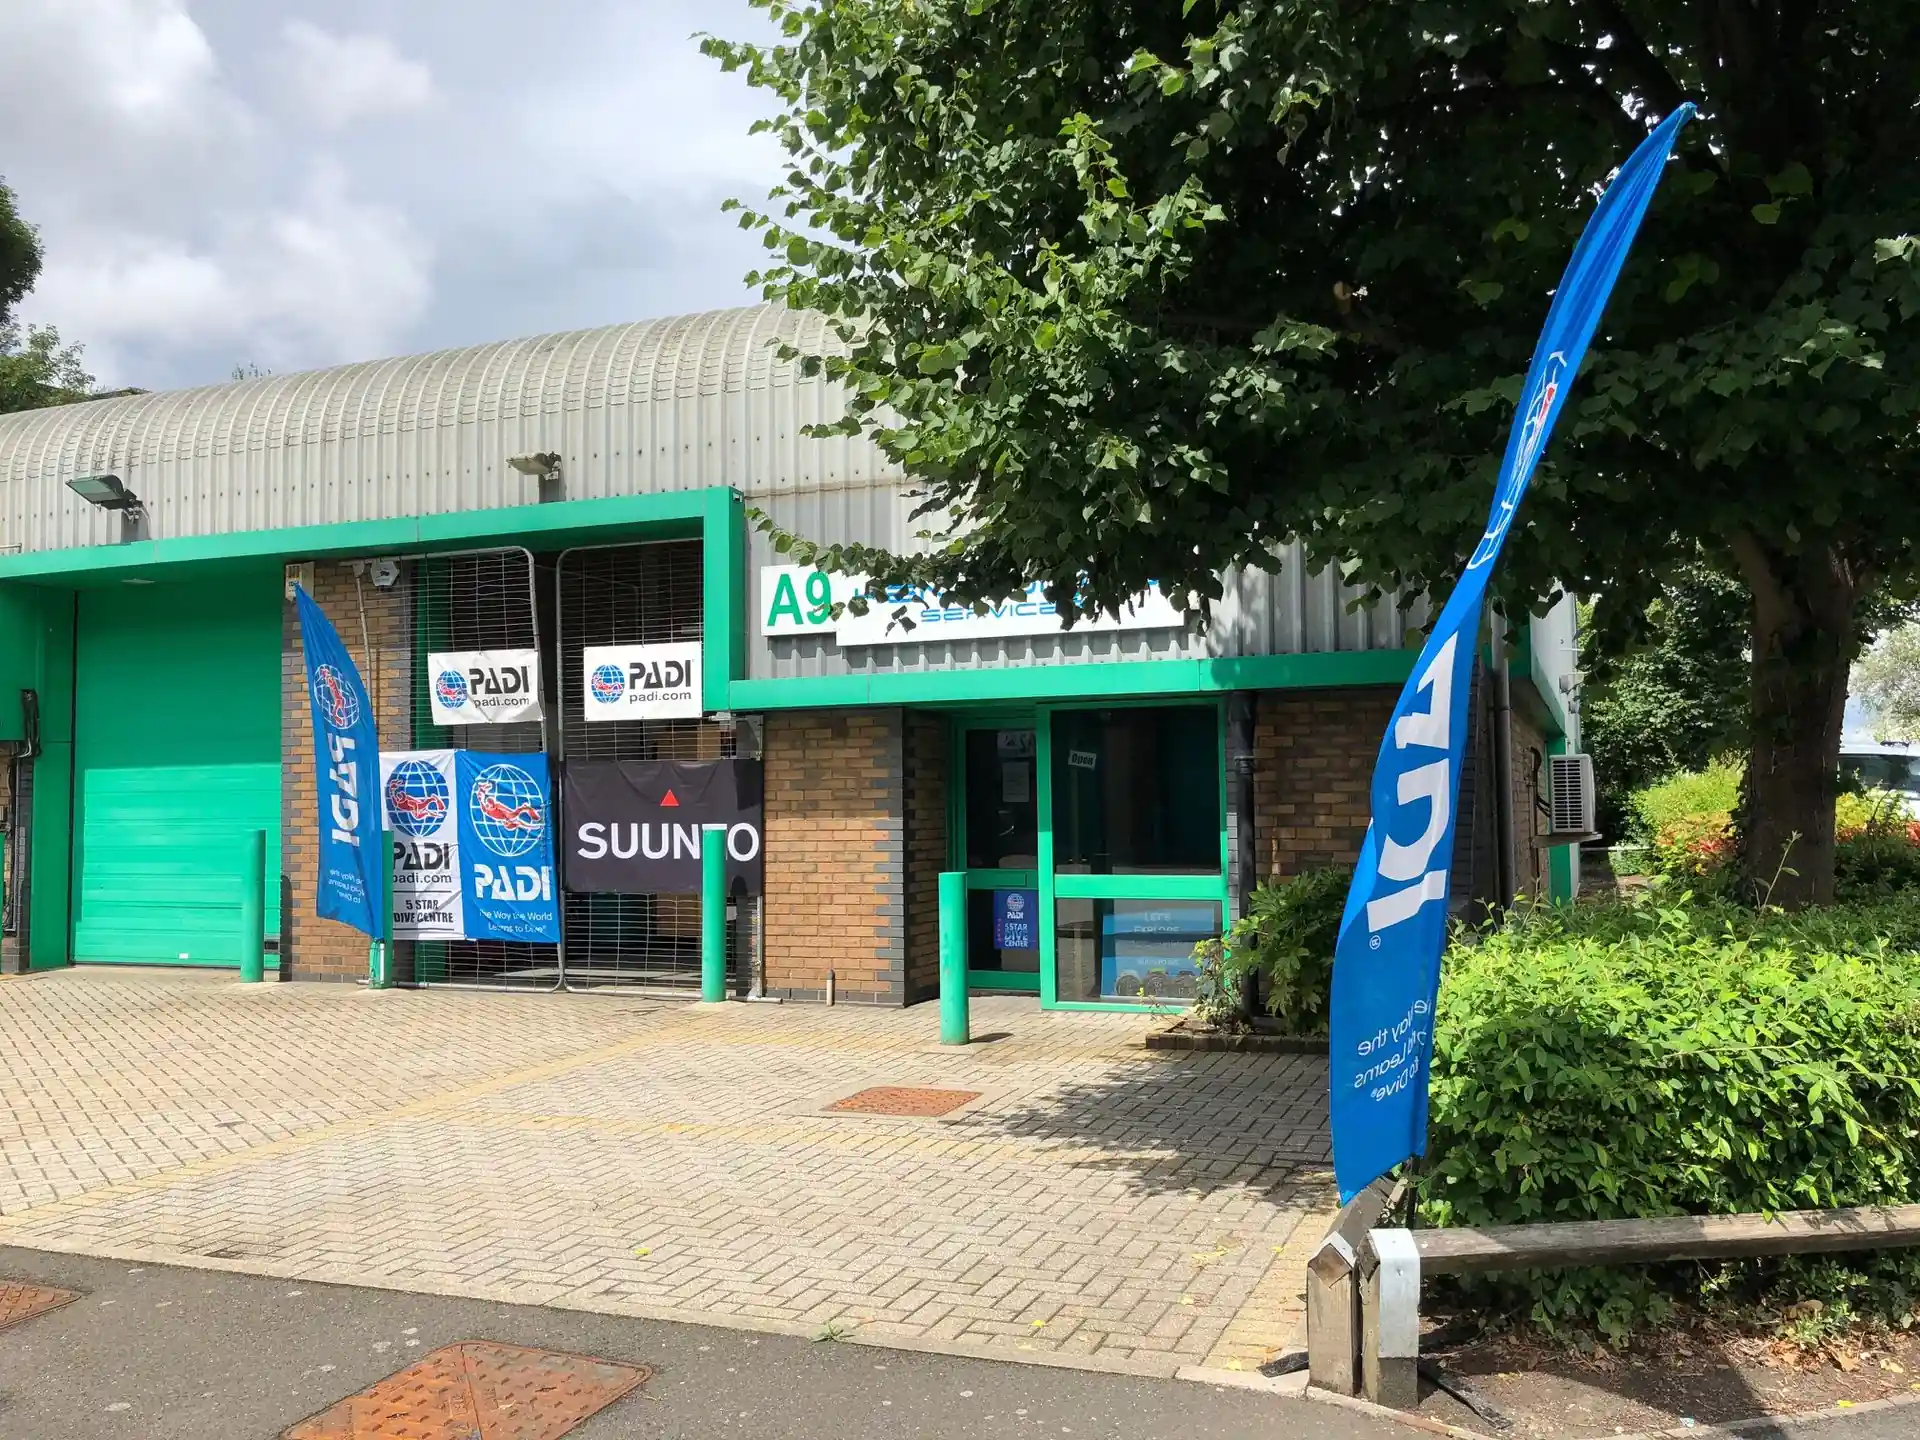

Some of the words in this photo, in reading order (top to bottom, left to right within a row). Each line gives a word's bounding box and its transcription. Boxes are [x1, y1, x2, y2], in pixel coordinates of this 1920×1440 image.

[767, 572, 831, 627] A9
[469, 665, 530, 695] PADI
[629, 660, 692, 690] PADI
[474, 697, 530, 709] padi.com
[629, 691, 692, 704] padi.com
[393, 842, 450, 870] PADI
[474, 864, 551, 901] PADI
[405, 900, 413, 910] 5
[415, 899, 439, 910] STAR
[394, 912, 415, 923] DIVE
[417, 912, 454, 924] CENTRE
[493, 910, 511, 921] Way
[527, 912, 553, 921] World
